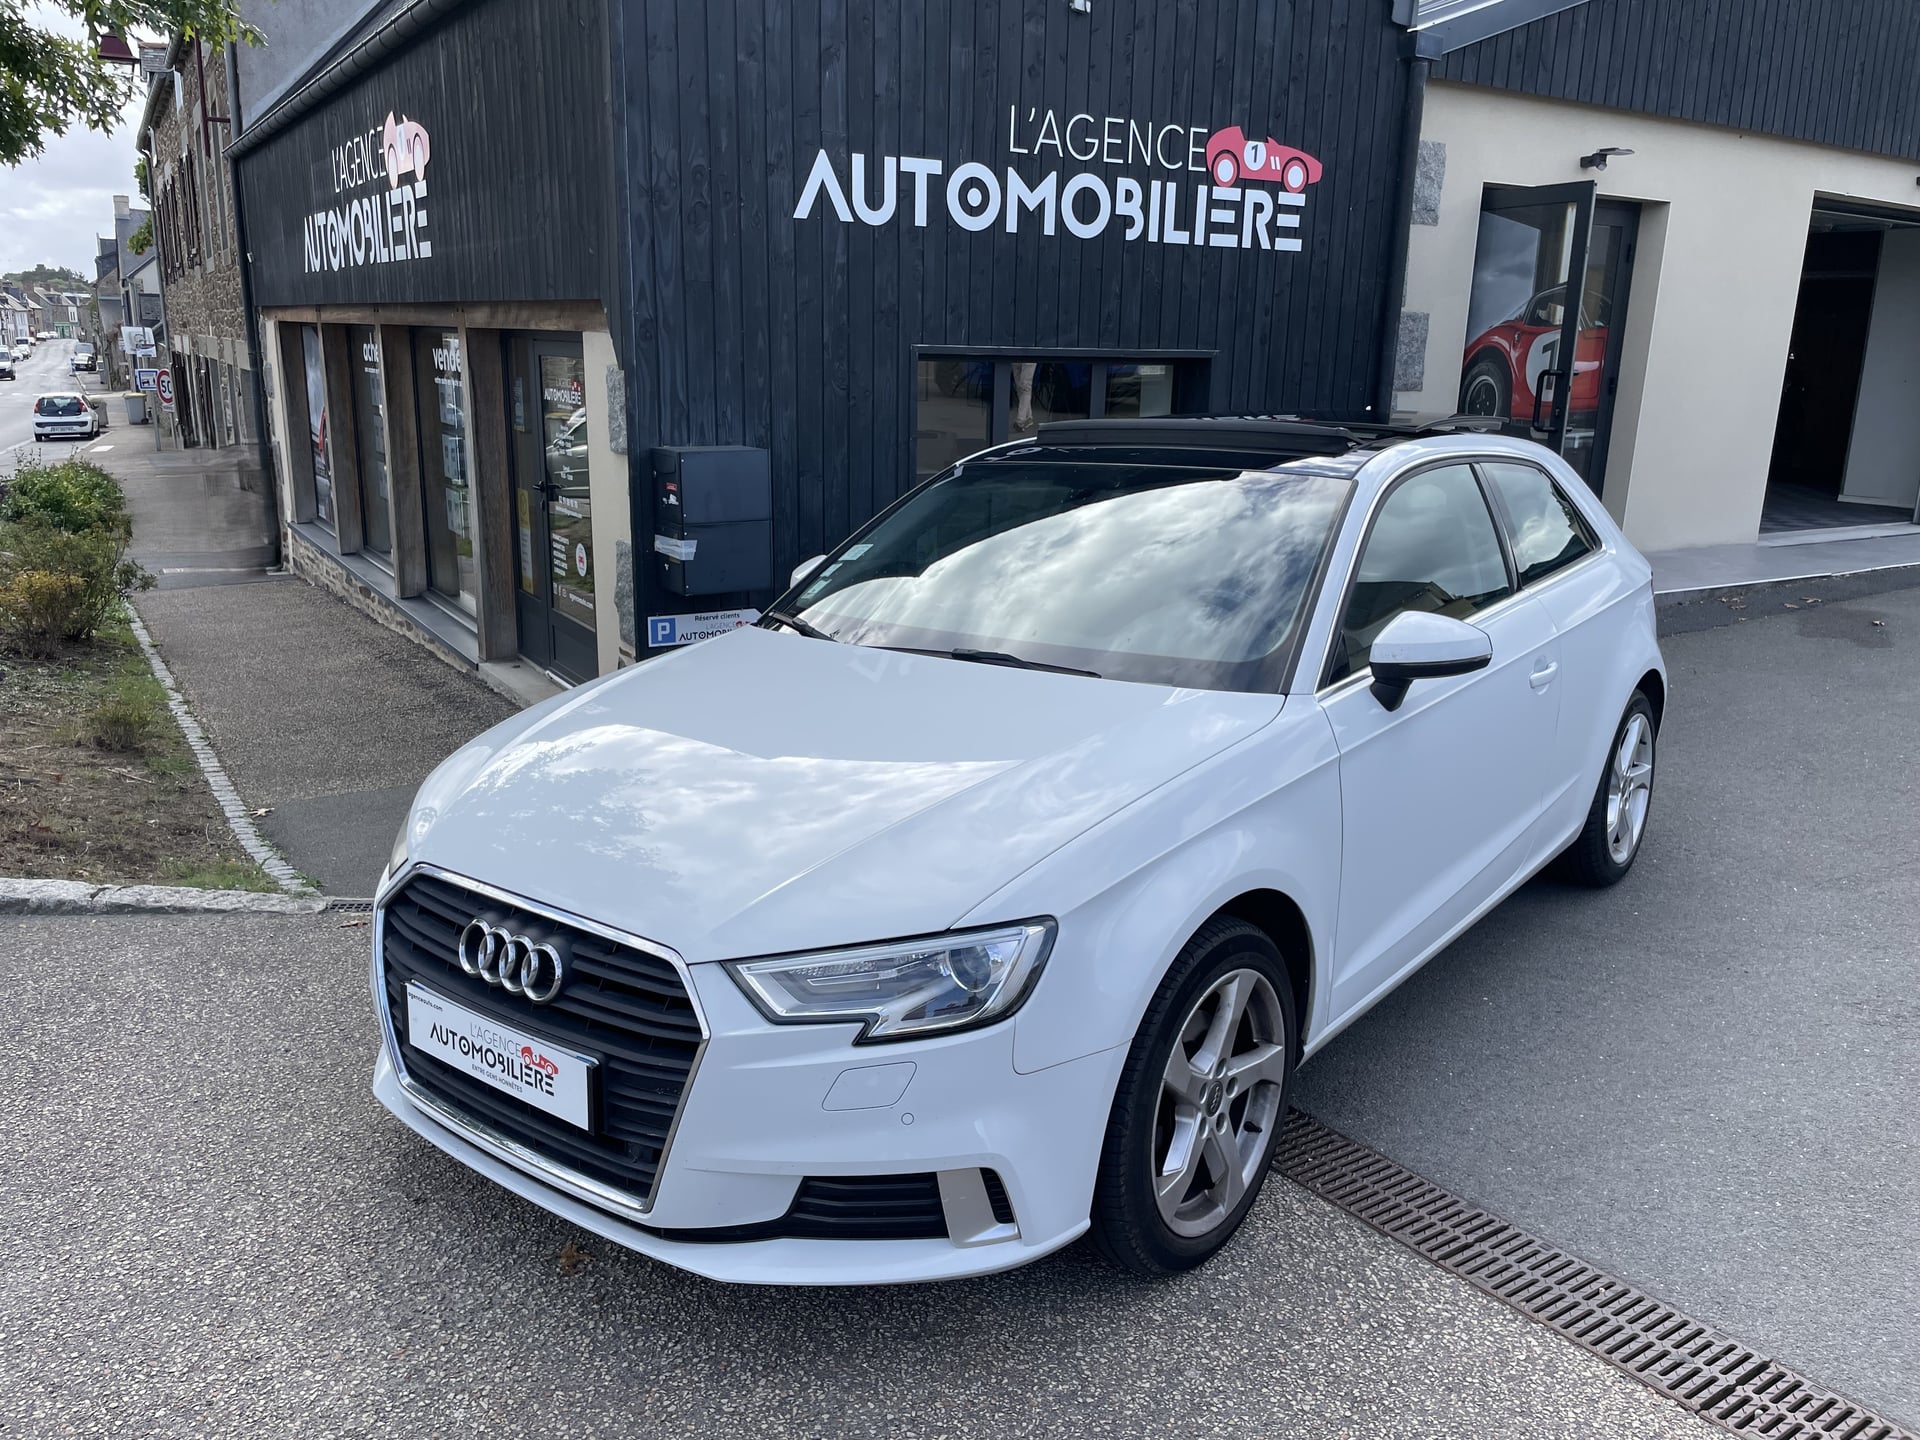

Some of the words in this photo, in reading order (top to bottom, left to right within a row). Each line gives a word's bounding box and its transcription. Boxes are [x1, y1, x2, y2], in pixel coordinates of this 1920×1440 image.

[1009, 104, 1209, 172] L'AGENCE
[1250, 143, 1259, 164] 1
[332, 126, 388, 193] L'AGENCE
[793, 148, 1306, 251] AUTOMOBILIERE
[304, 179, 432, 273] AUTOMOBILIERE
[363, 332, 380, 362] ache
[432, 336, 462, 373] vende
[657, 622, 671, 641] P
[678, 628, 733, 641] AUTOMO
[694, 613, 719, 622] Réservé
[720, 612, 740, 620] clients
[470, 1022, 522, 1058] L'AGENCE
[430, 1021, 555, 1097] AUTOMOBILIERE
[486, 1070, 498, 1081] GENS
